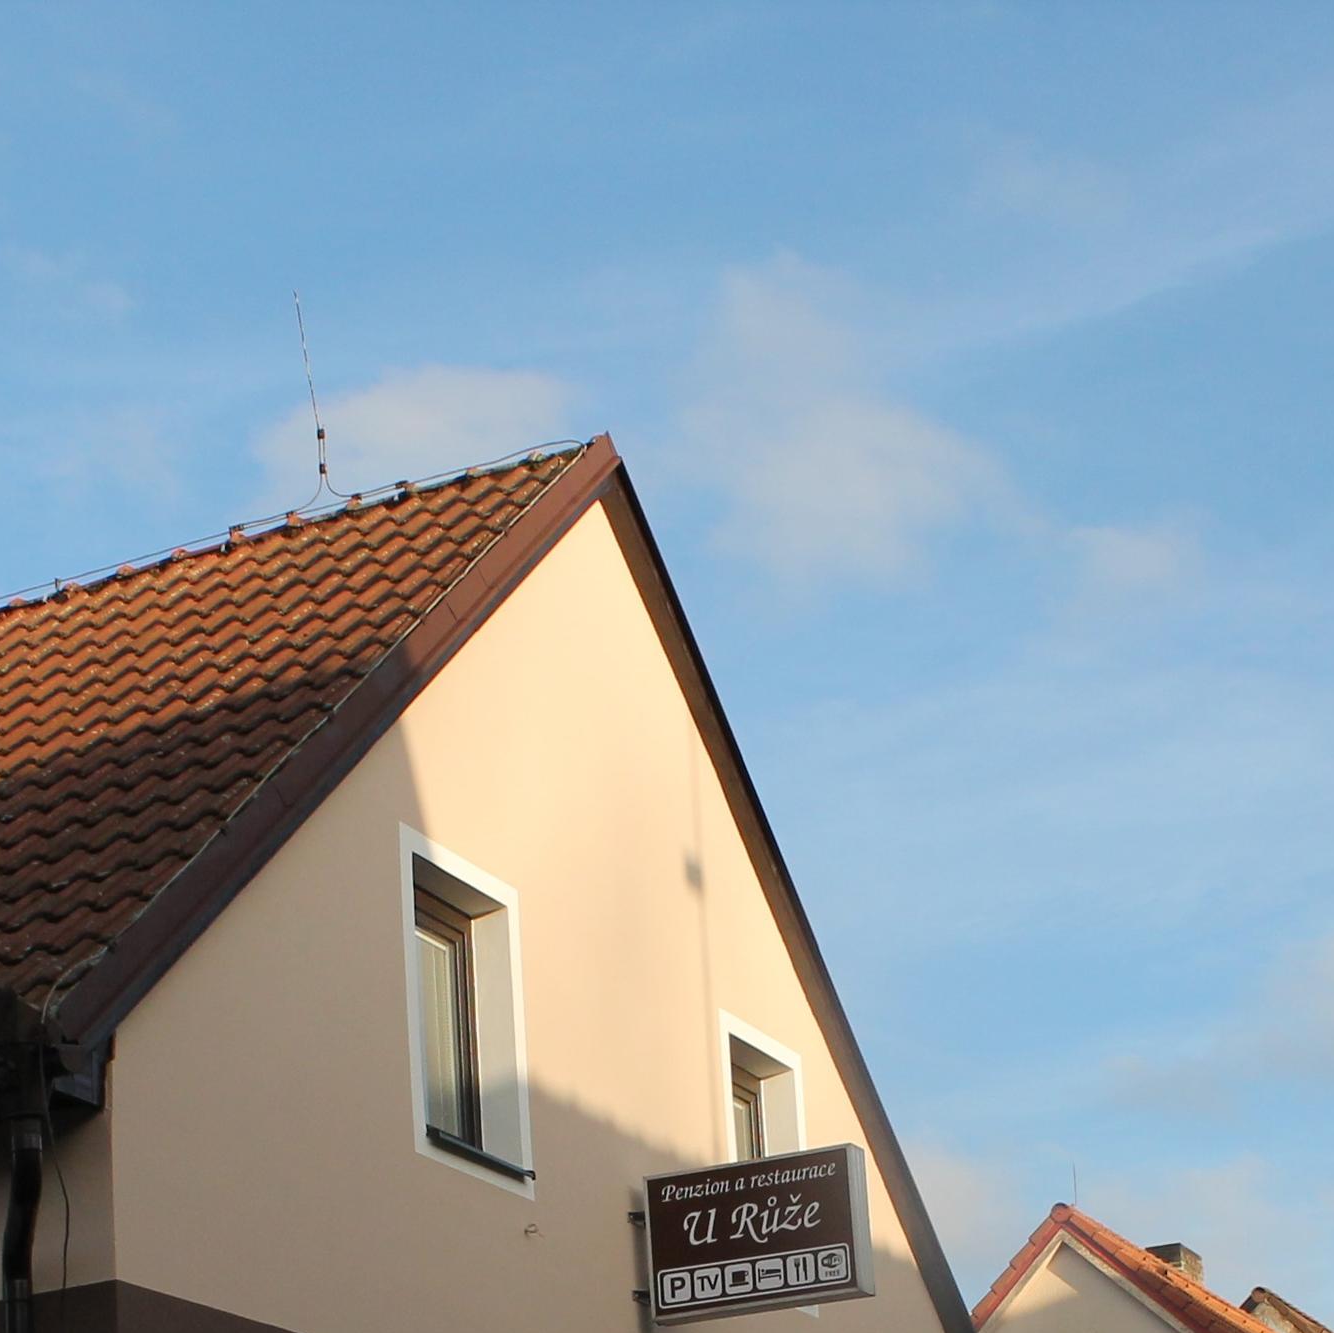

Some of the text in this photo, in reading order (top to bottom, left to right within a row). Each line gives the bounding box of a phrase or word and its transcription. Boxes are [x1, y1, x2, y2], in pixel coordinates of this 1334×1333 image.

[661, 1161, 837, 1203] Penzion a restaurace
[682, 1193, 822, 1246] U Růže
[696, 1274, 720, 1293] TV
